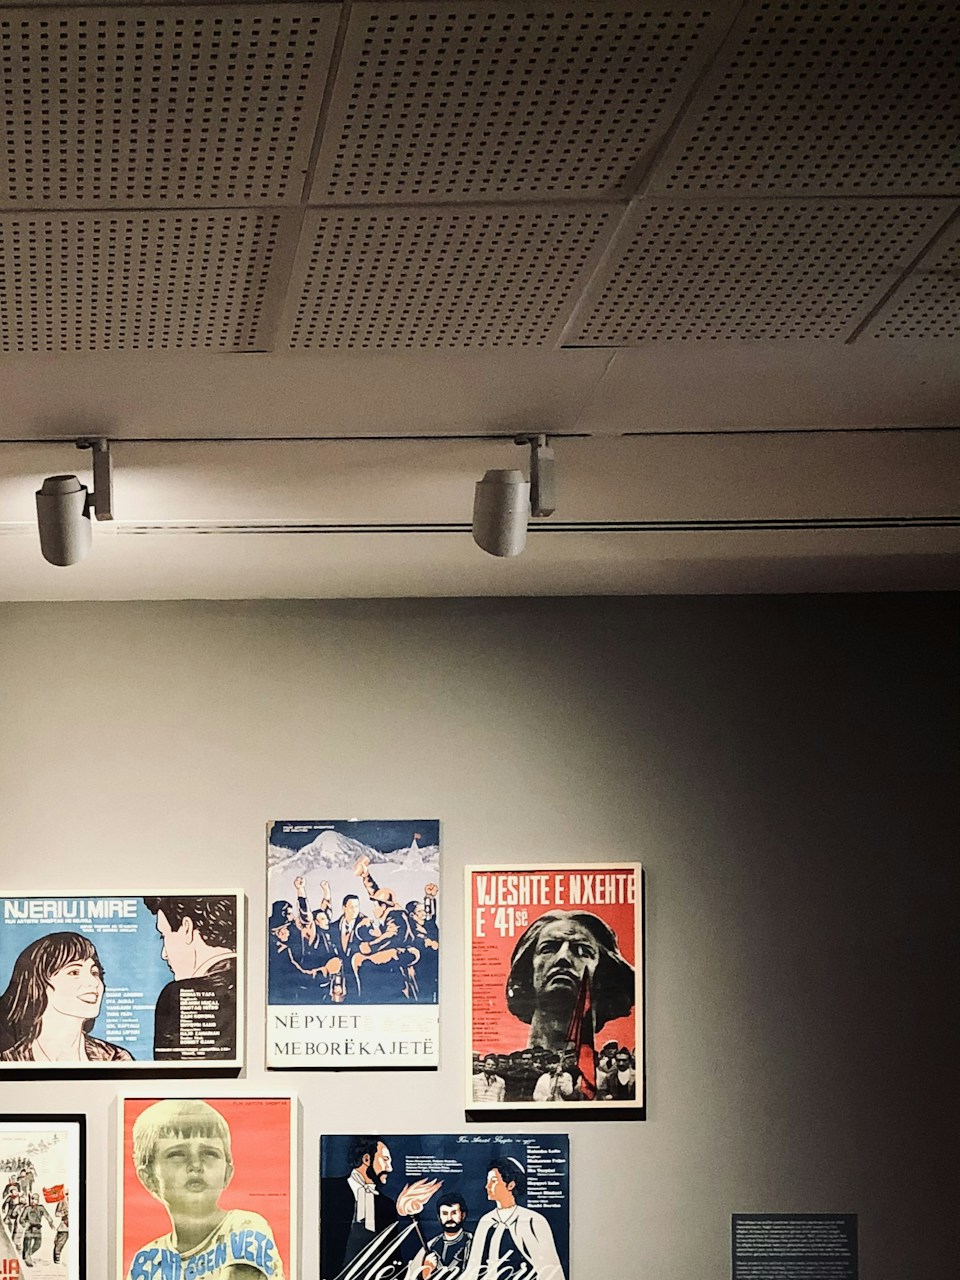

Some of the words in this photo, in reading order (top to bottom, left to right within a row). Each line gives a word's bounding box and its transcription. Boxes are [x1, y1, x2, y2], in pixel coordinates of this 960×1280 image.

[476, 874, 550, 905] VJESHTE
[554, 874, 565, 904] E
[4, 899, 78, 919] NJERIU
[80, 899, 86, 918] I
[87, 899, 138, 918] MIRE
[476, 907, 486, 938] E
[230, 1229, 276, 1276] VETE
